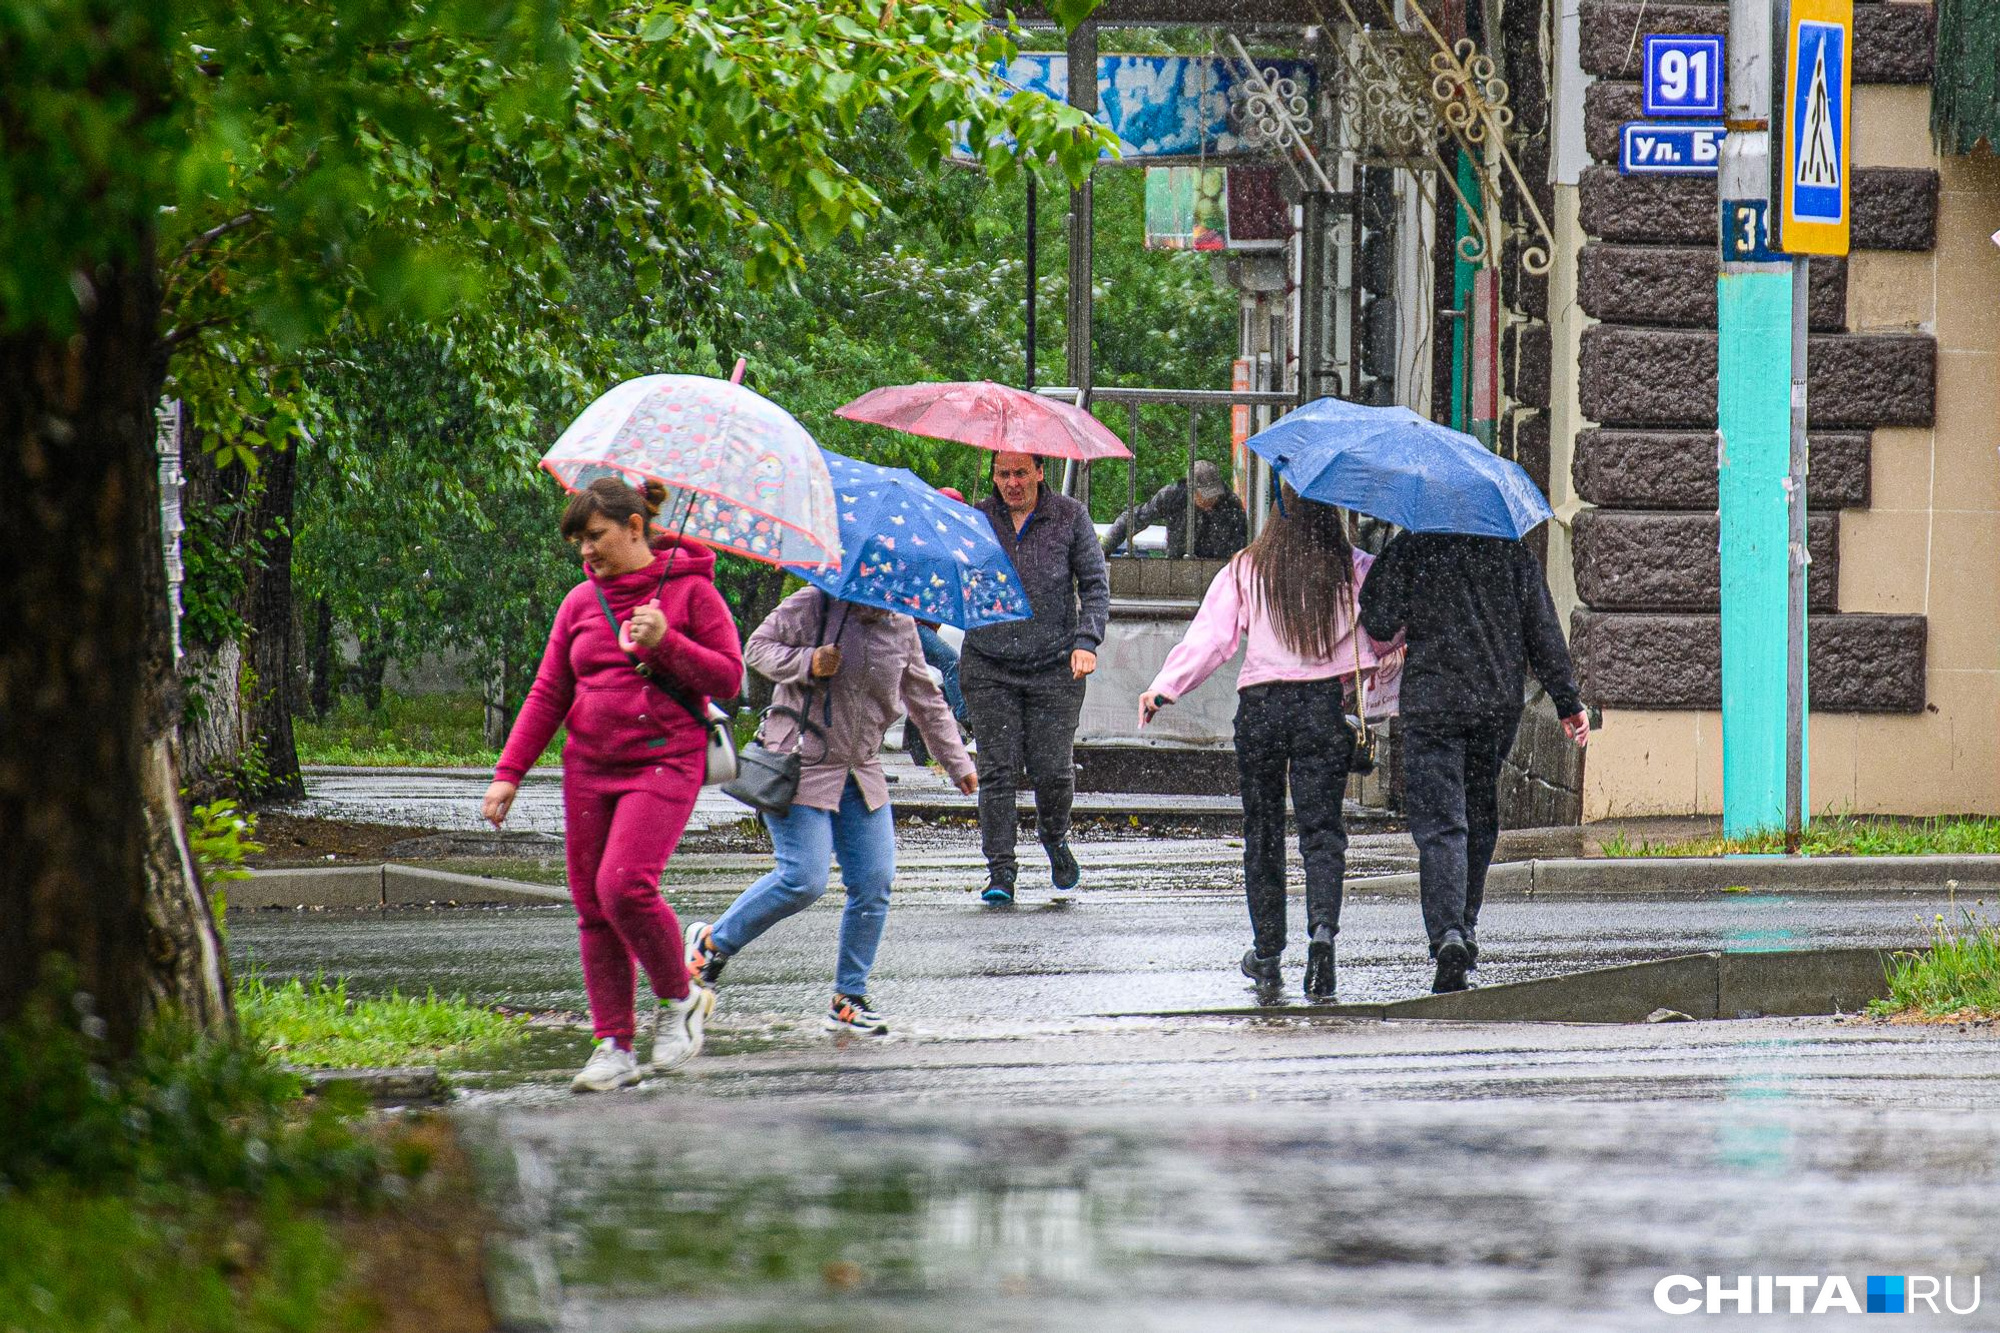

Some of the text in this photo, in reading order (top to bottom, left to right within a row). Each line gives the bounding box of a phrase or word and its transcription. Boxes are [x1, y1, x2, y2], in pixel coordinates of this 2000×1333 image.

[1660, 49, 1707, 100] 91
[1635, 136, 1681, 161] Ул.
[1737, 207, 1768, 251] 3
